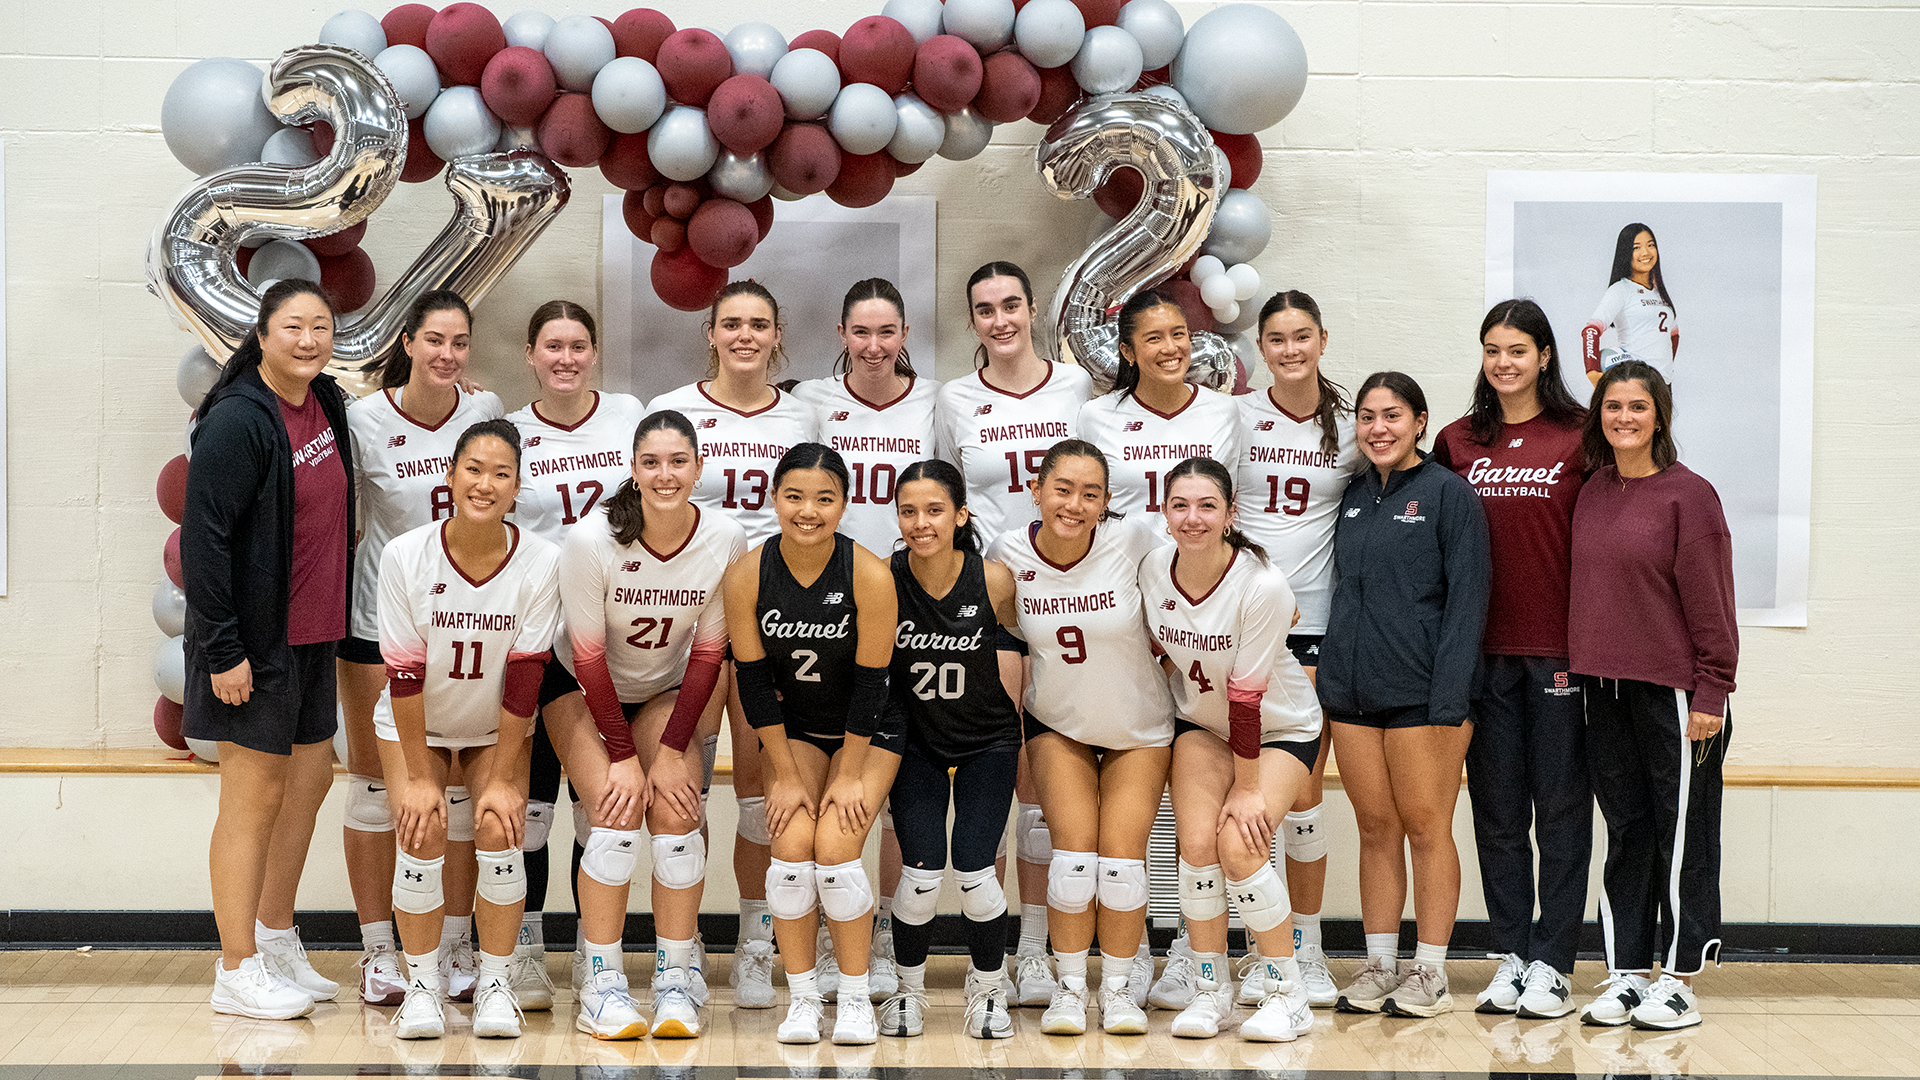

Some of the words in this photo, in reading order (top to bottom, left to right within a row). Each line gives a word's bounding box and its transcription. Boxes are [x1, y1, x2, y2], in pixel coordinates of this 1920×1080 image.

[1658, 311, 1668, 333] 2
[831, 436, 921, 455] SWARTHMORE
[980, 422, 1069, 444] SWARTHMORE
[396, 456, 452, 479] SWARTH
[530, 450, 623, 477] SWARTHMORE
[1123, 444, 1213, 461] SWARTHMORE
[1250, 446, 1338, 469] SWARTHMORE
[851, 463, 897, 505] 10
[1467, 457, 1565, 485] Garnet
[431, 485, 454, 521] 8
[556, 480, 604, 525] 12
[722, 469, 769, 511] 13
[1145, 471, 1171, 513] 1
[1264, 475, 1311, 517] 19
[1474, 486, 1551, 498] VOLLEYBALL
[614, 587, 706, 606] SWARTHMORE
[1023, 590, 1116, 615] SWARTHMORE
[626, 617, 674, 649] 21
[761, 608, 851, 640] Garnet
[895, 620, 984, 652] Garnet
[1159, 625, 1233, 652] SWARTHMORE
[448, 641, 484, 680] 11
[1056, 625, 1087, 665] 9
[791, 649, 822, 682] 2
[910, 662, 966, 701] 20
[1188, 660, 1214, 694] 4
